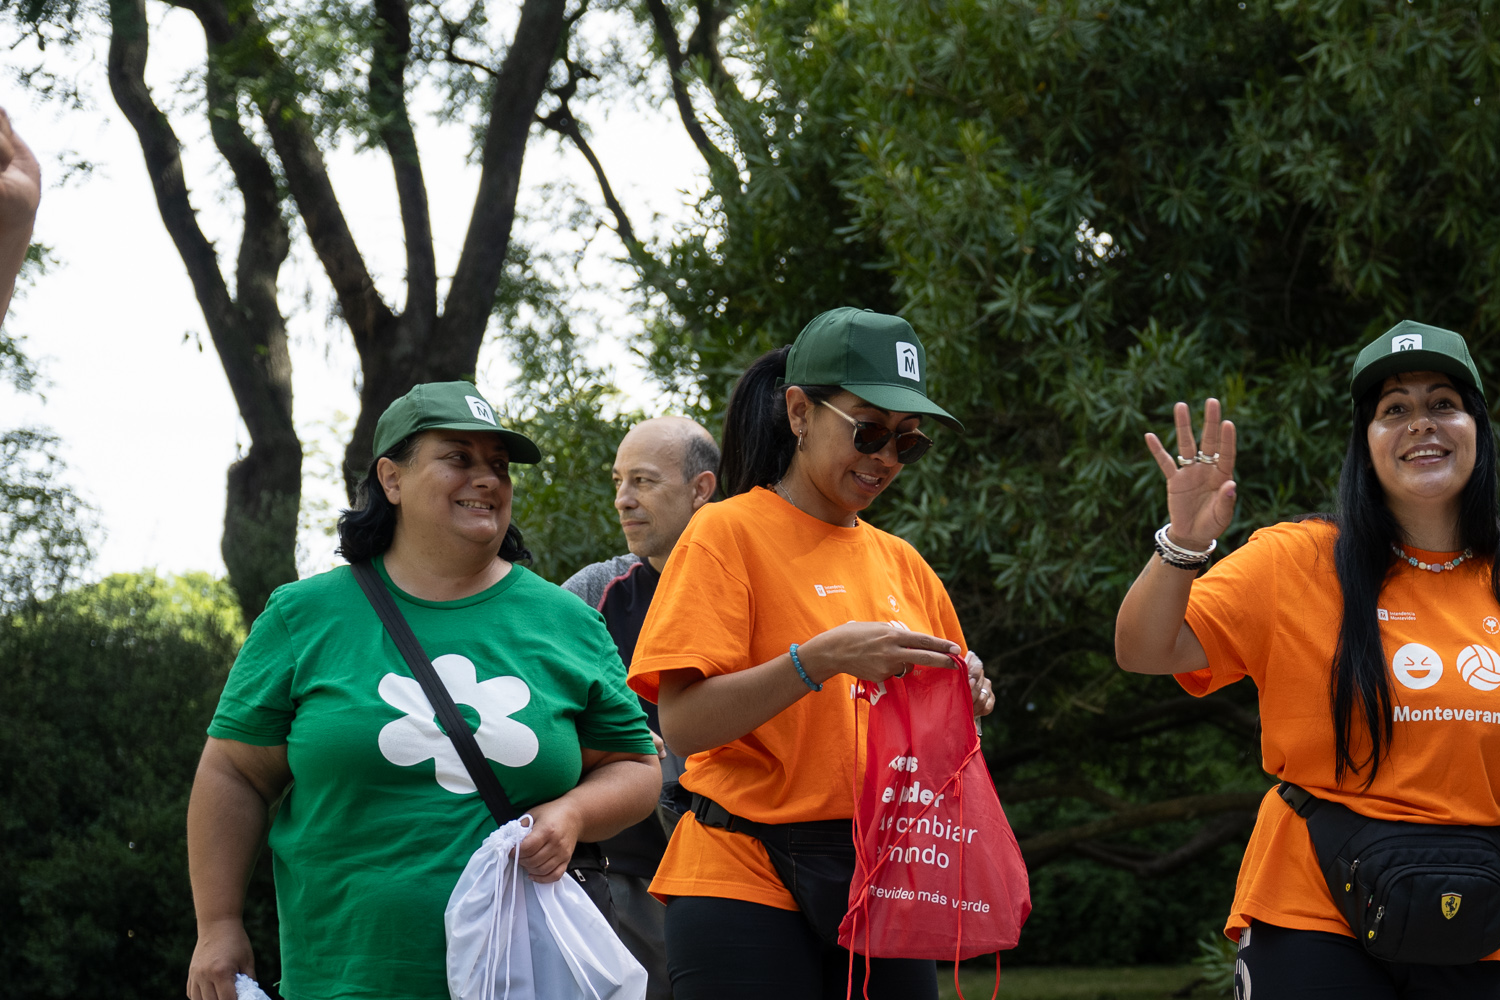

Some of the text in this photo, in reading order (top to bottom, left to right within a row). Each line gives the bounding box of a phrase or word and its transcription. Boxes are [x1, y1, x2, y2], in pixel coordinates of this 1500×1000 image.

[905, 356, 915, 374] M
[476, 406, 490, 419] M
[917, 890, 948, 905] más
[951, 898, 990, 913] verde
